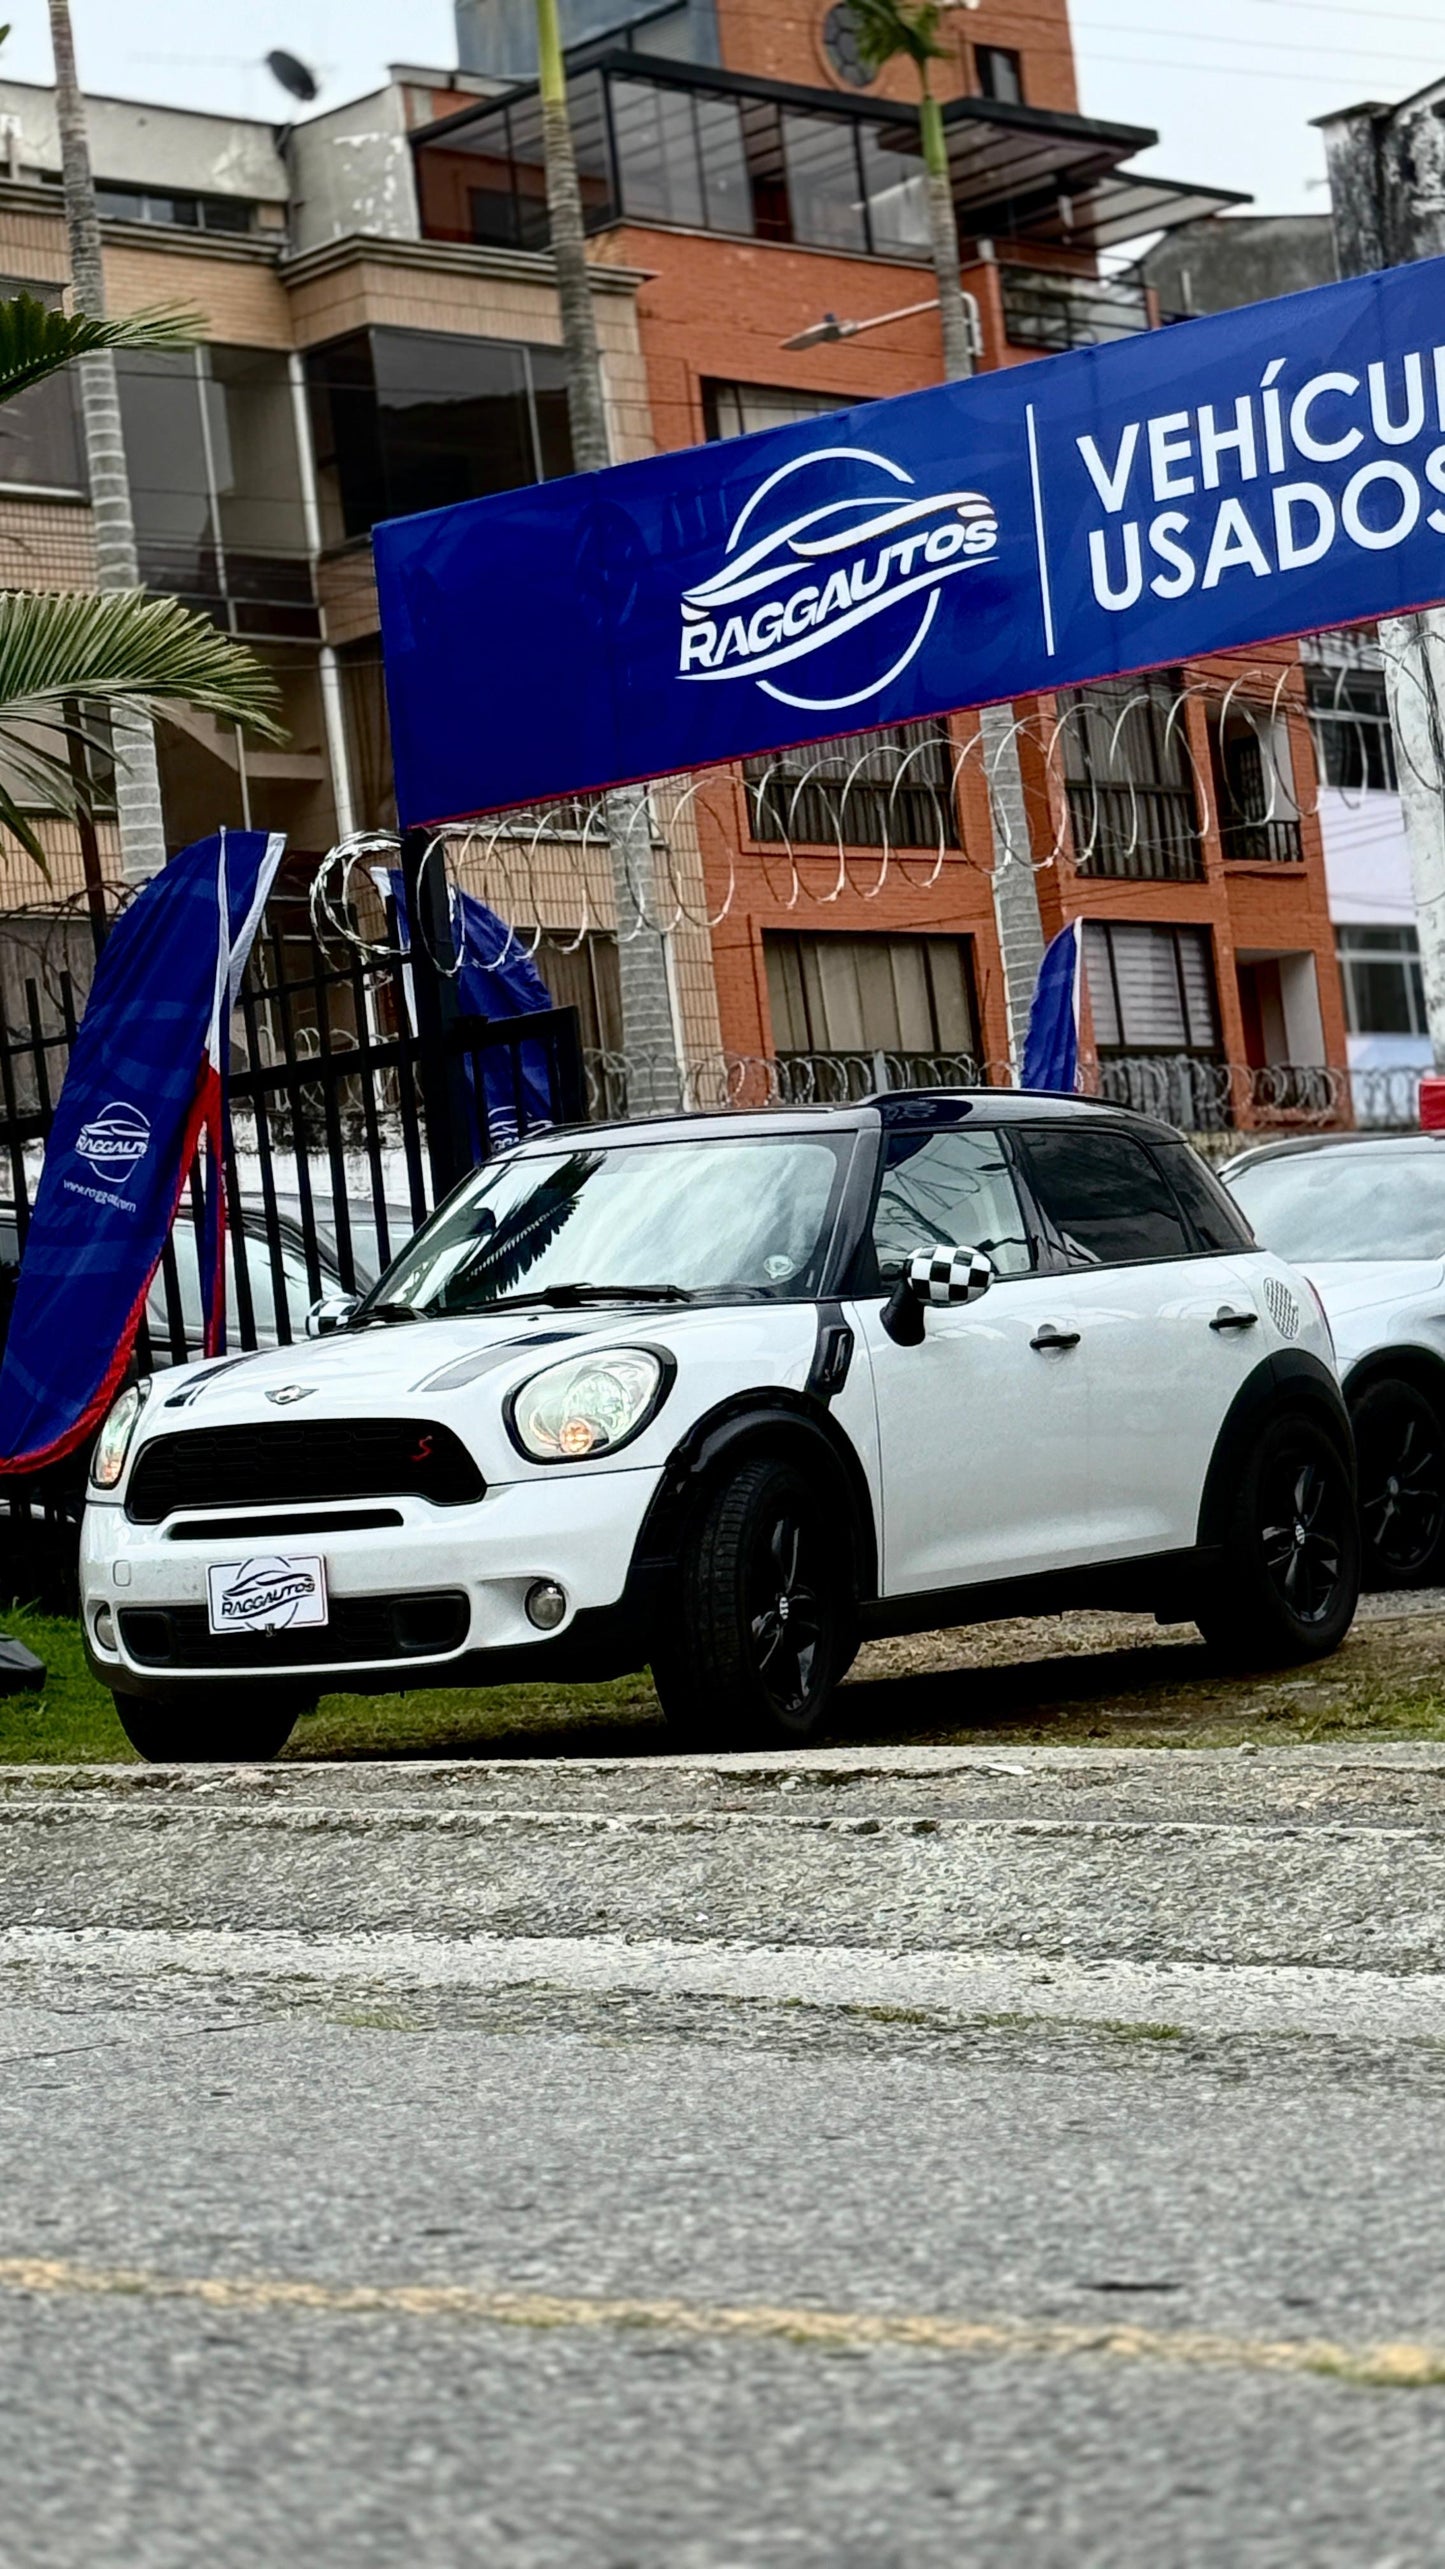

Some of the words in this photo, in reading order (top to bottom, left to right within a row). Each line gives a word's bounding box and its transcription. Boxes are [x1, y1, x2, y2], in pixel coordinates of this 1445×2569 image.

[679, 519, 998, 672] RAGGAUTOS
[411, 1435, 432, 1461] S
[221, 1582, 316, 1616] RAGGAUTOS
